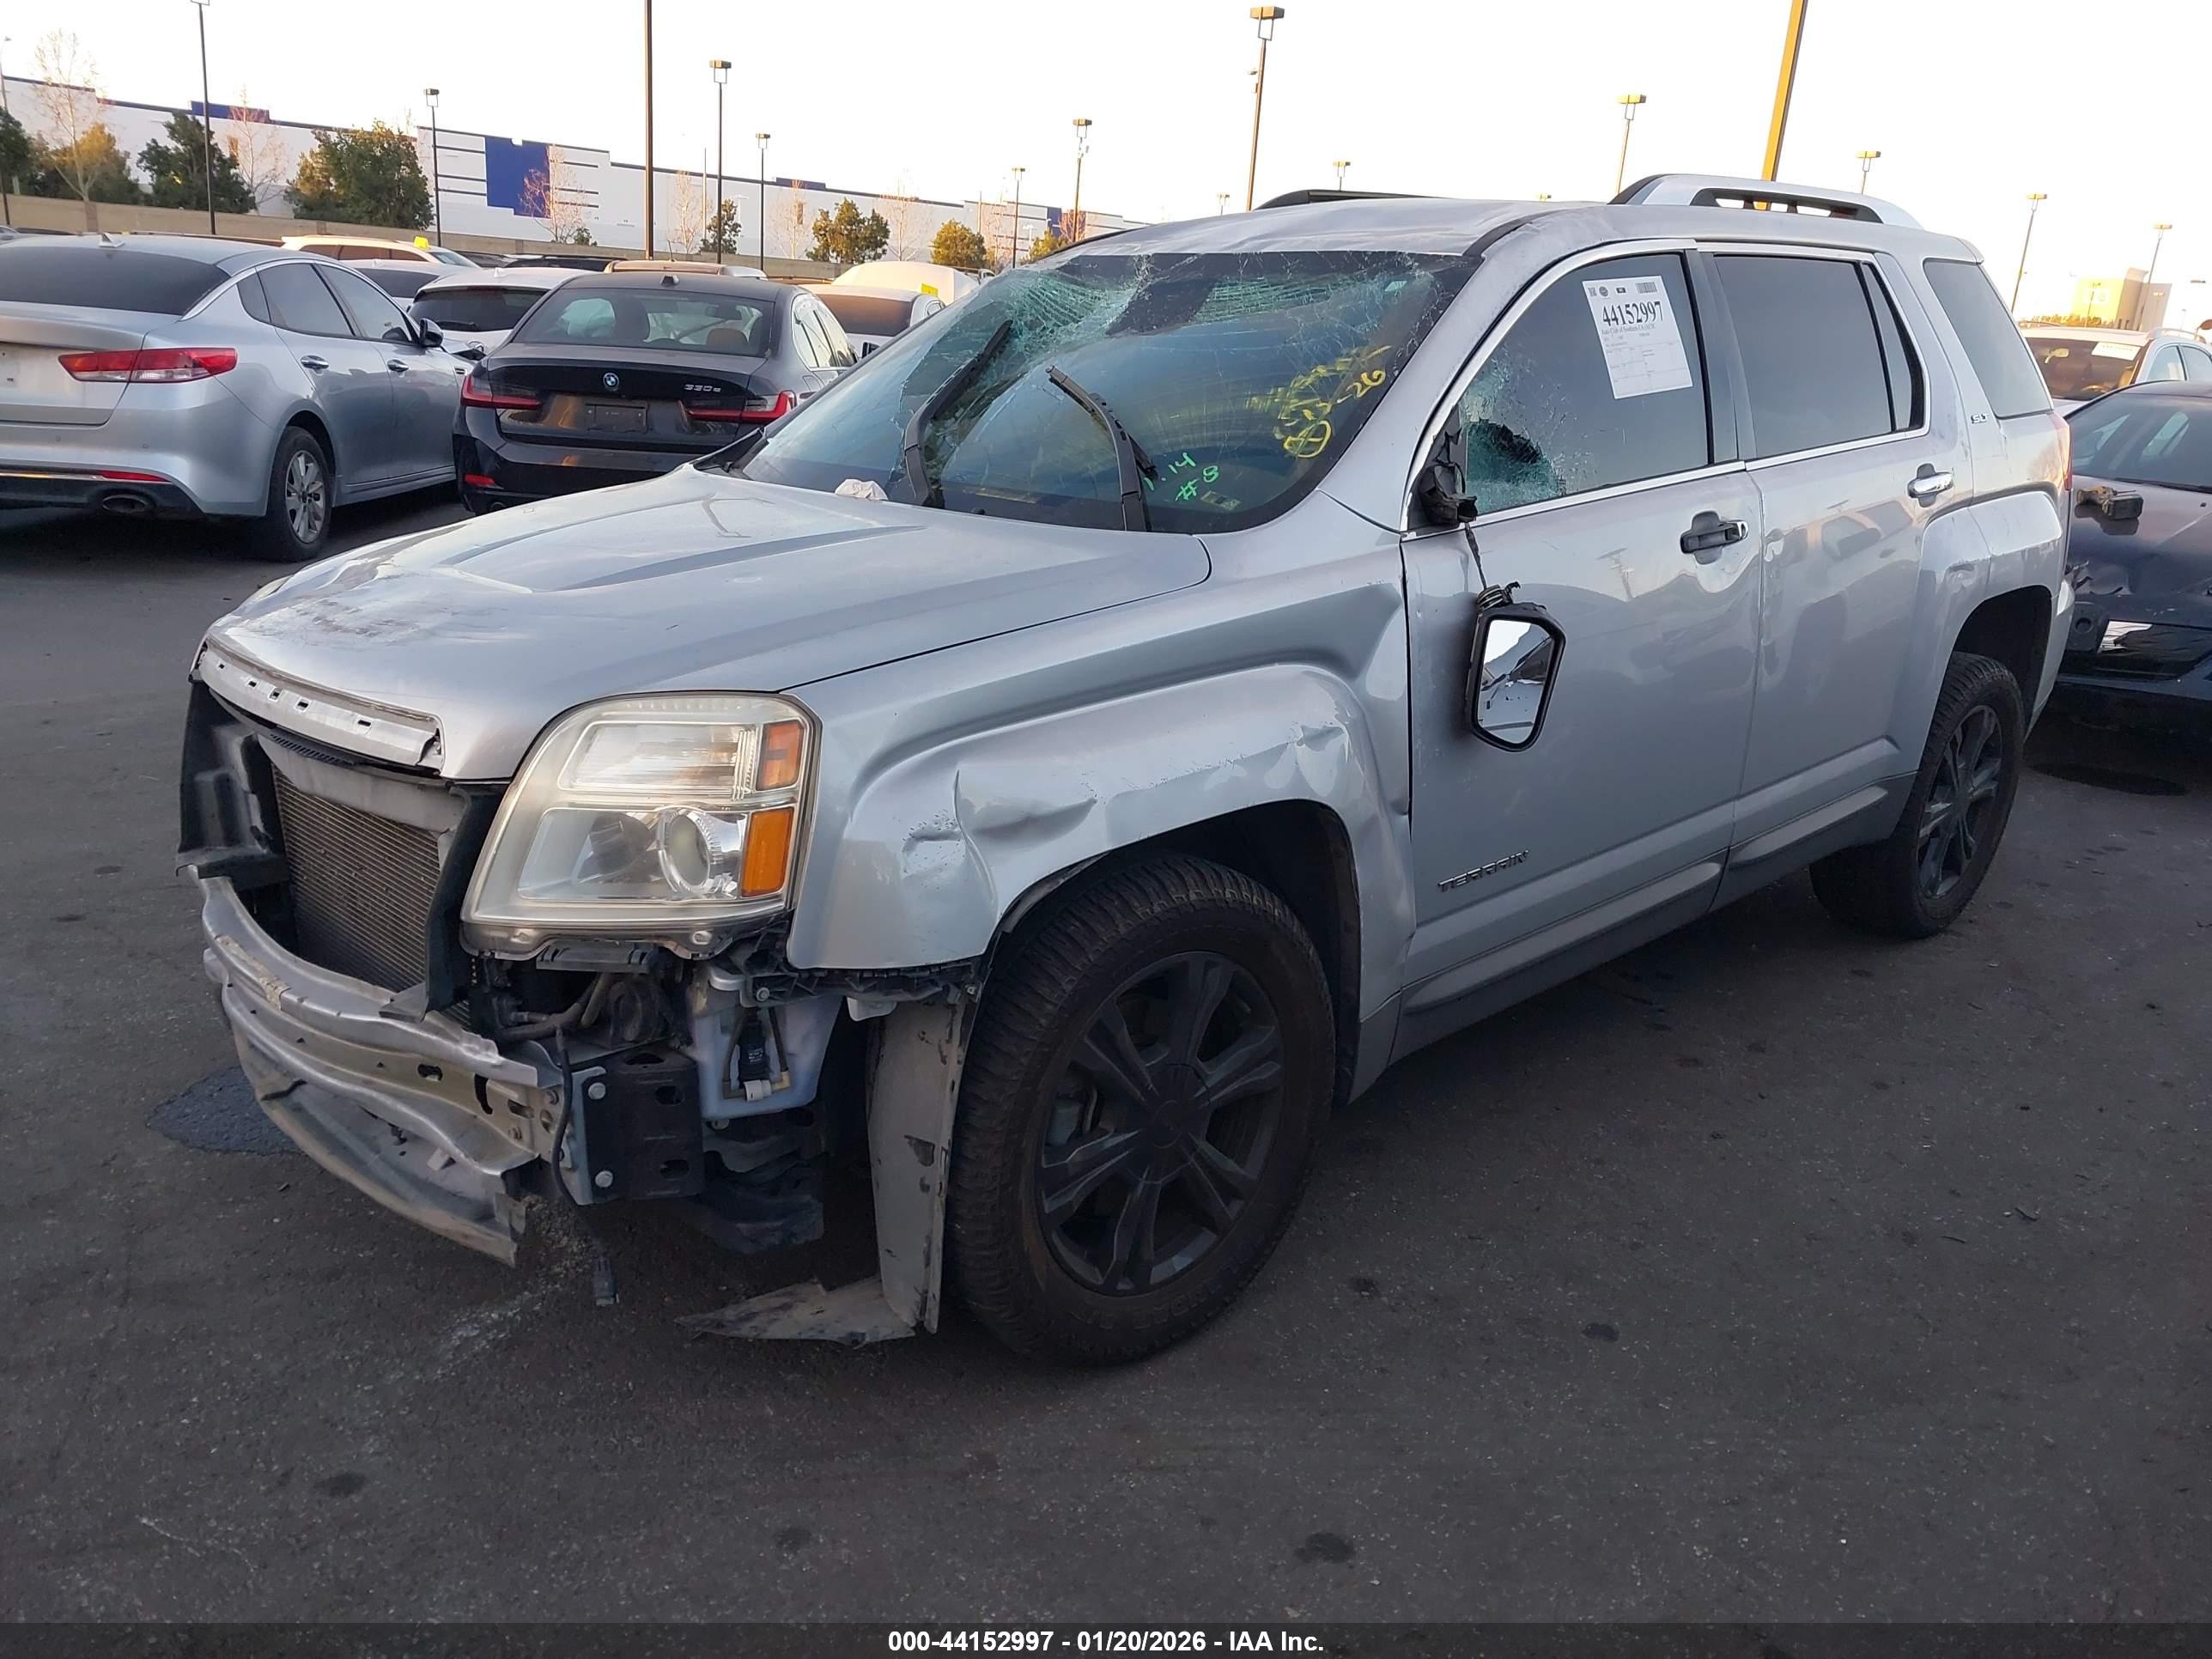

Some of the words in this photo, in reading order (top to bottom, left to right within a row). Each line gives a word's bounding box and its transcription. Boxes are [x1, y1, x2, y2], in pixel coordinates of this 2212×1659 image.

[1602, 301, 1663, 327] 44152997
[684, 384, 722, 392] 330e
[1437, 850, 1529, 892] TERRAIN
